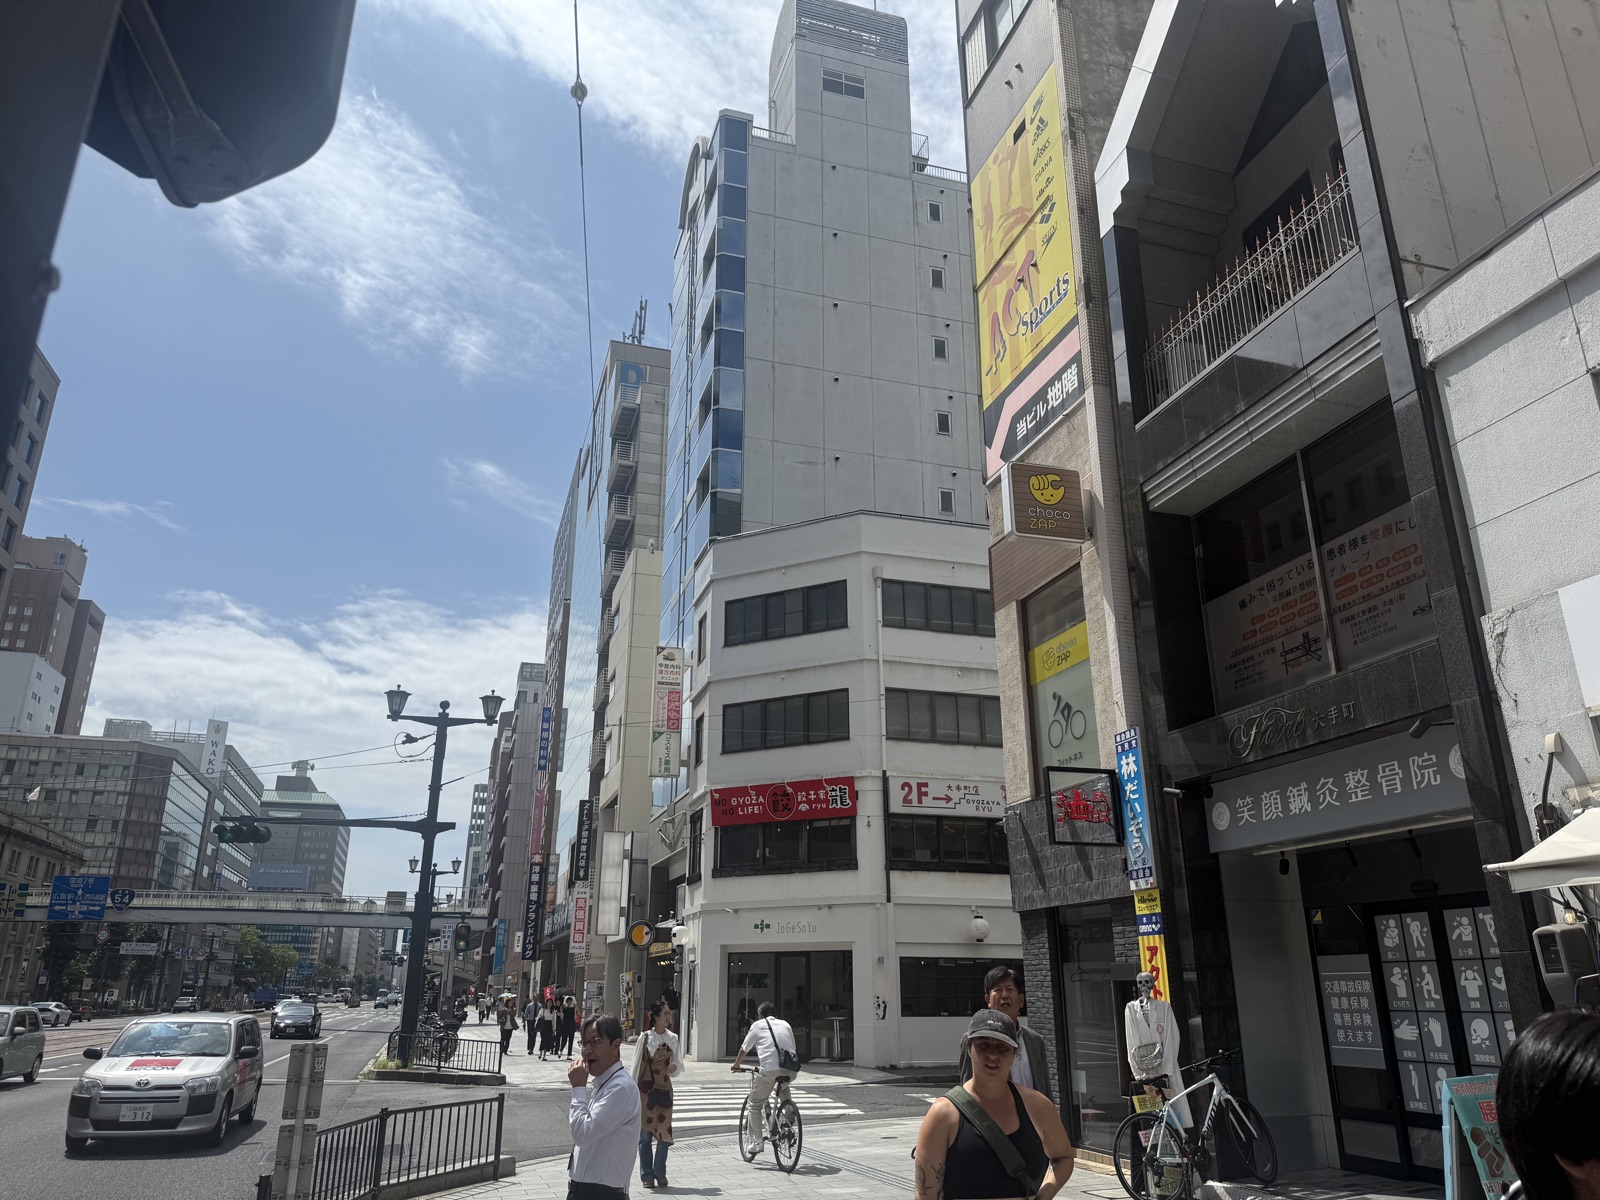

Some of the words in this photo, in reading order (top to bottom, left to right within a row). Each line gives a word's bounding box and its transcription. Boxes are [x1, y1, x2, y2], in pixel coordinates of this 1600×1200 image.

[1034, 155, 1053, 182] DIANA
[1021, 271, 1070, 337] sports
[1016, 363, 1078, 440] 当ビル地階
[1028, 505, 1071, 520] choco
[1029, 518, 1057, 530] ZAP
[1326, 516, 1417, 561] 患者様を笑顔にし
[1329, 551, 1371, 578] グループ
[1238, 557, 1315, 612] 痛みで困っている
[1055, 636, 1078, 654] choco
[1056, 650, 1071, 666] ZAP
[1312, 700, 1356, 731] 大手町
[539, 722, 549, 767] 幸福の科学
[1117, 740, 1137, 753] 自民党
[206, 739, 220, 775] WAKO
[663, 733, 671, 774] コスモス薬局
[1057, 751, 1083, 767] フィットネス
[797, 789, 827, 802] 餃子家
[900, 781, 929, 805] 2F
[946, 783, 980, 794] 大手町店
[1235, 751, 1441, 826] 笑顔鍼灸整骨院
[714, 798, 727, 807] NO
[731, 795, 765, 805] GYOZA
[828, 785, 851, 809] 龍
[721, 807, 734, 816] NO
[738, 806, 763, 815] LIFE!
[1120, 752, 1144, 858] 林だいぞう
[531, 854, 543, 863] 本
[1131, 868, 1151, 880] 後援会
[114, 894, 130, 903] 54
[1137, 895, 1158, 905] ellesse
[573, 897, 587, 944] 高価買取
[776, 921, 817, 934] JoGeSaYu
[1138, 924, 1152, 933] arena
[1387, 951, 1400, 959] 肩こり
[1324, 980, 1372, 993] 交通事故保険
[1331, 996, 1370, 1010] 健康保険
[1393, 1000, 1411, 1008] むち打ち
[1333, 1012, 1373, 1026] 傷害保険
[1337, 1029, 1374, 1043] 使えます
